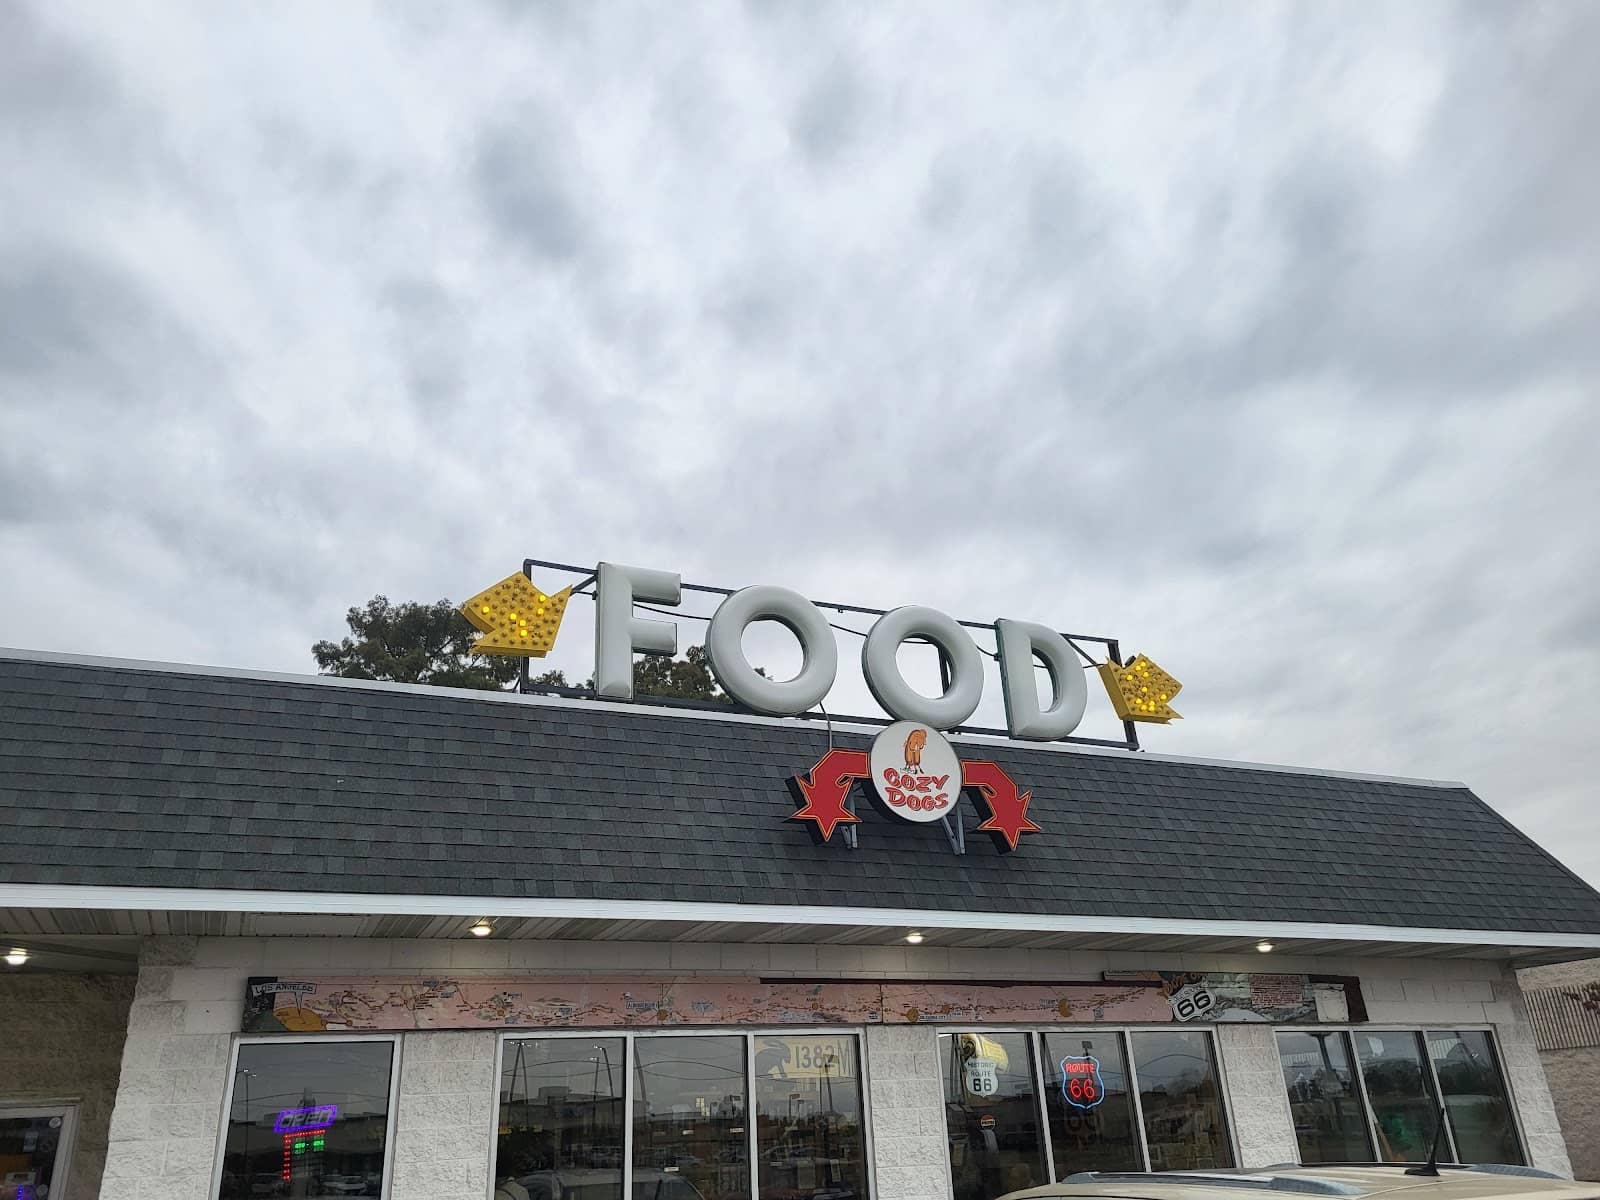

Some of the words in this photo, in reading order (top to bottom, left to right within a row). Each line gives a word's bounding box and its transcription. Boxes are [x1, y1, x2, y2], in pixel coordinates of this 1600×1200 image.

[594, 561, 1088, 741] FOOD
[883, 768, 950, 793] COZY
[884, 787, 949, 811] DOGS
[1177, 990, 1210, 1018] 66
[795, 1044, 836, 1069] 1382
[1065, 1063, 1095, 1073] ROUTE
[973, 1078, 992, 1092] 66
[1070, 1078, 1095, 1099] 66
[280, 1108, 333, 1128] OPEN
